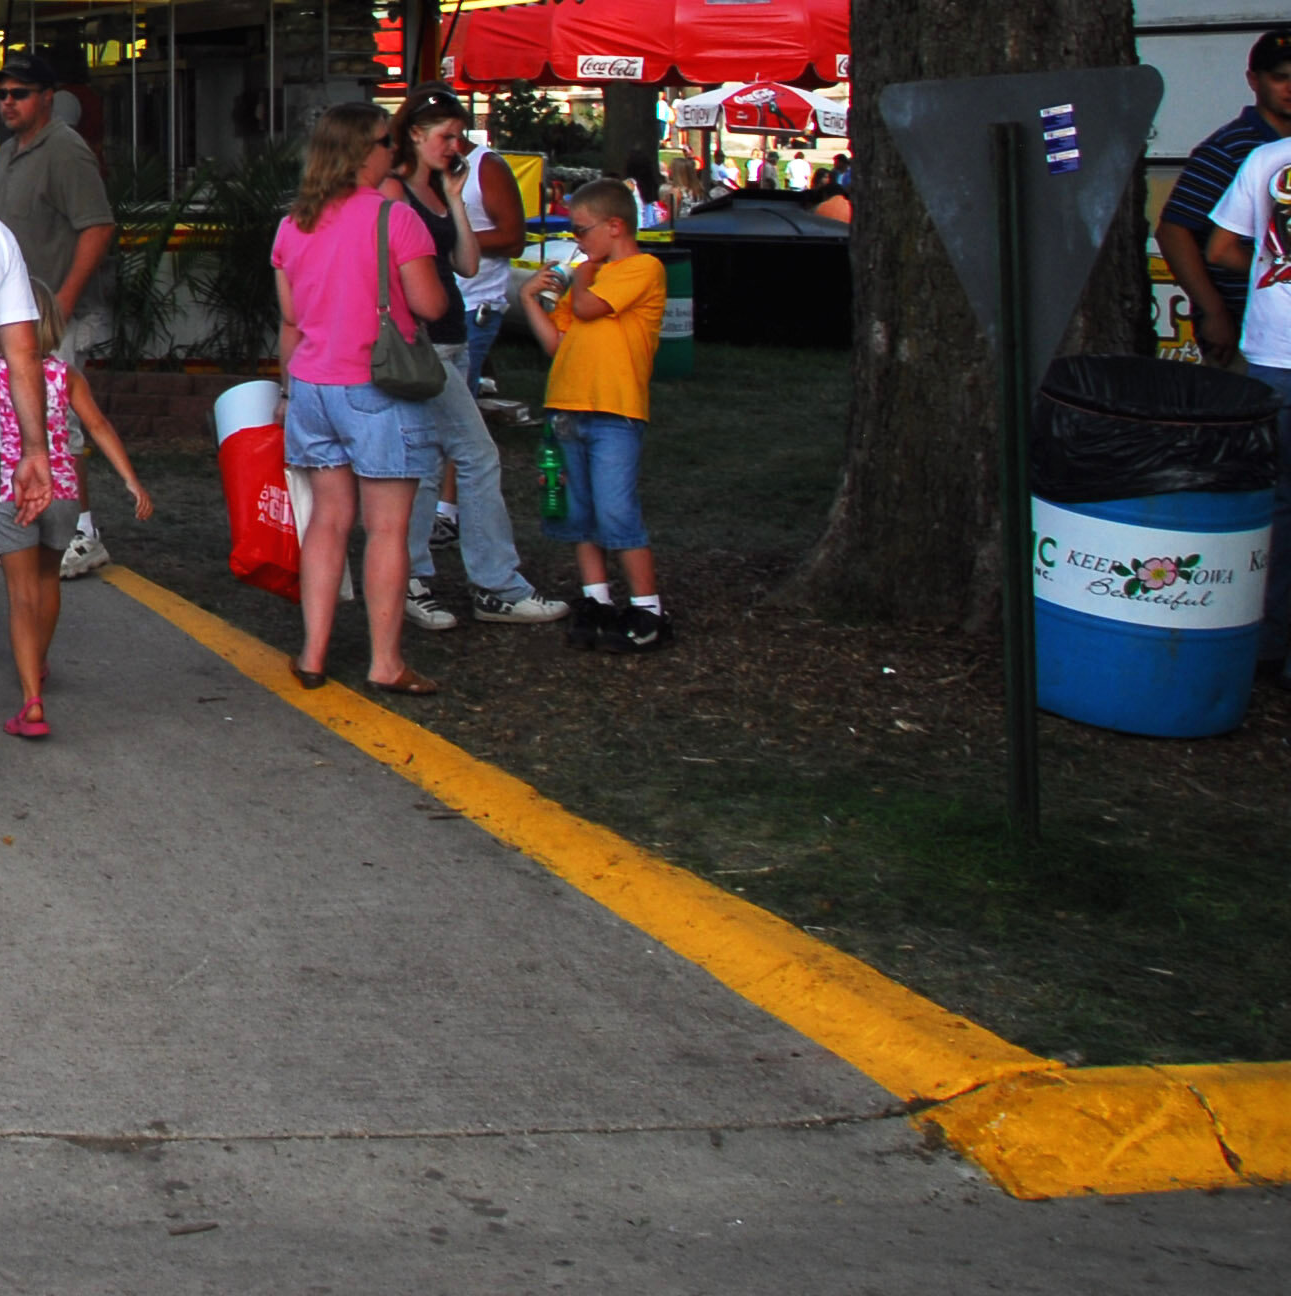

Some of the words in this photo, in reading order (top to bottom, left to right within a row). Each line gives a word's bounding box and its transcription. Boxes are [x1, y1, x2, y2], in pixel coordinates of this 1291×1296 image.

[580, 58, 638, 77] Coca-Cola
[683, 105, 709, 124] Enjoy
[823, 111, 845, 129] Enjo
